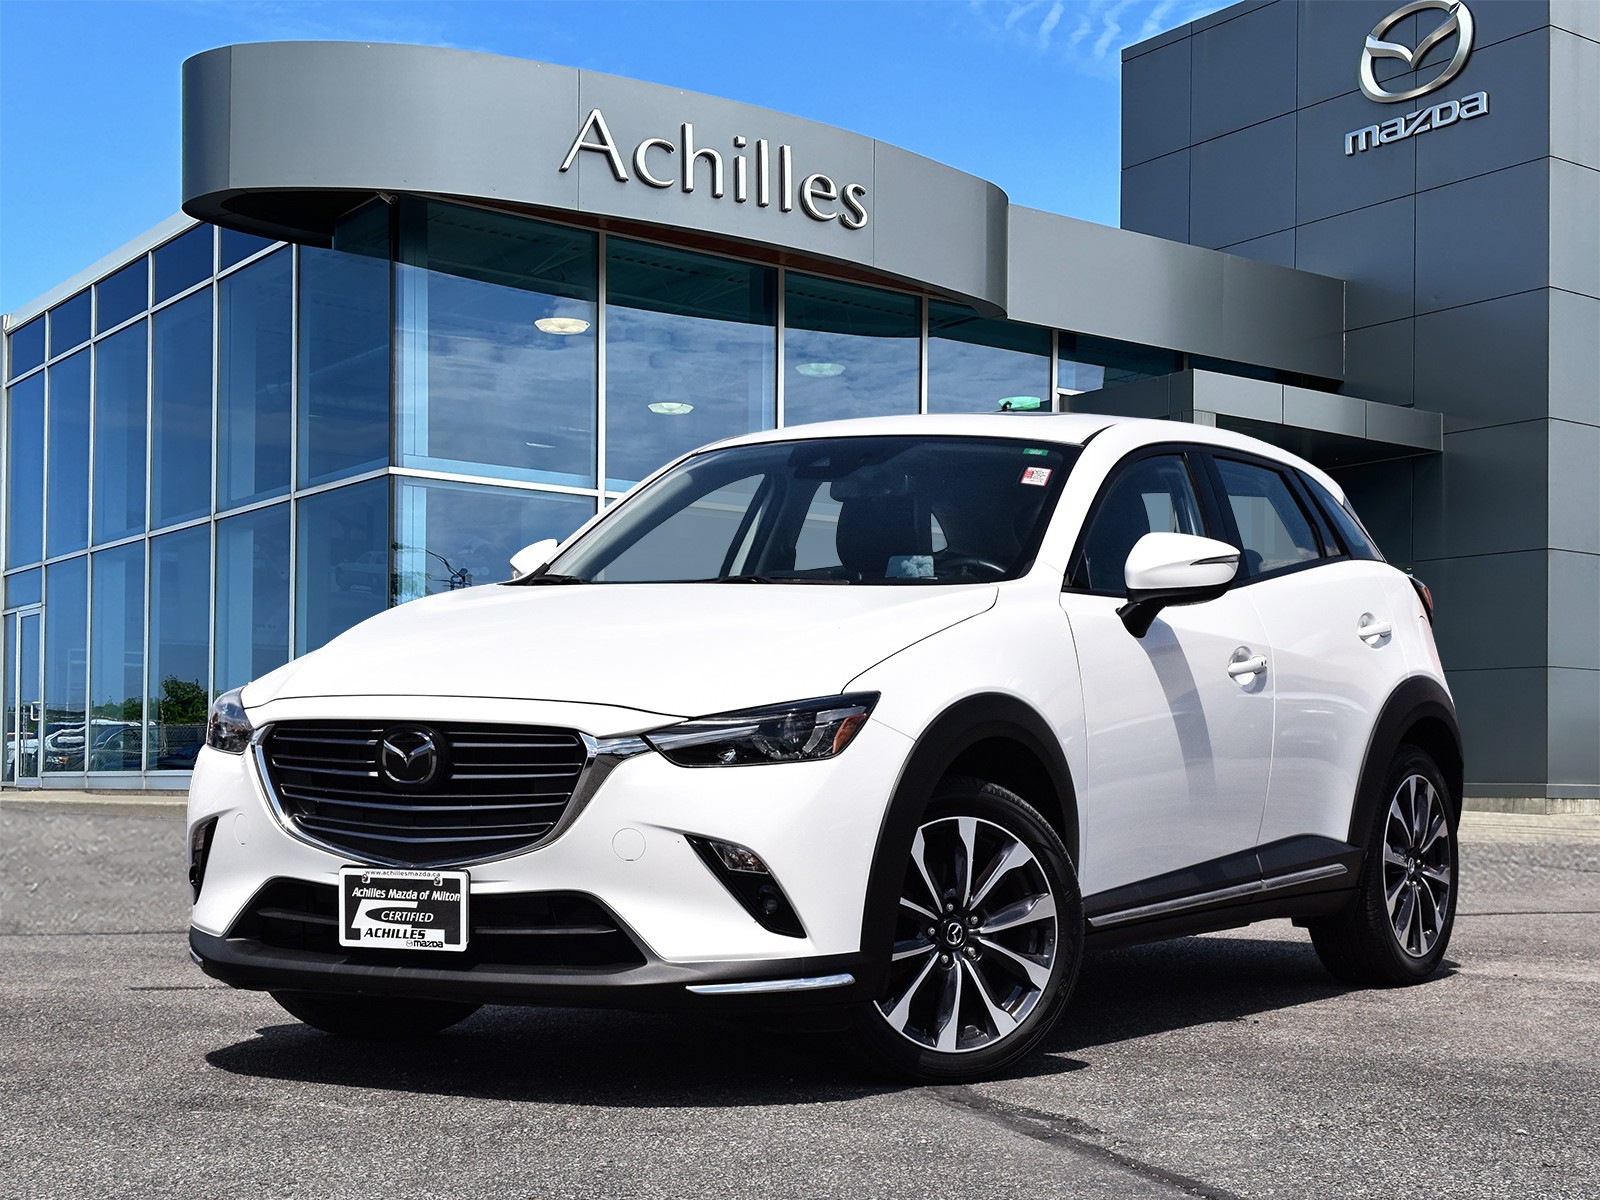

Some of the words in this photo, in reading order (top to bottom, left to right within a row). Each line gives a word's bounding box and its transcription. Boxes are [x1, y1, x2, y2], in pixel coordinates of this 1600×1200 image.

[558, 108, 868, 230] Achilles
[352, 887, 386, 898] Achilles
[388, 889, 417, 900] Mazda
[420, 891, 430, 900] of
[431, 891, 461, 902] Milton
[380, 911, 434, 922] CERTIFIED
[364, 928, 426, 939] ACHILLES
